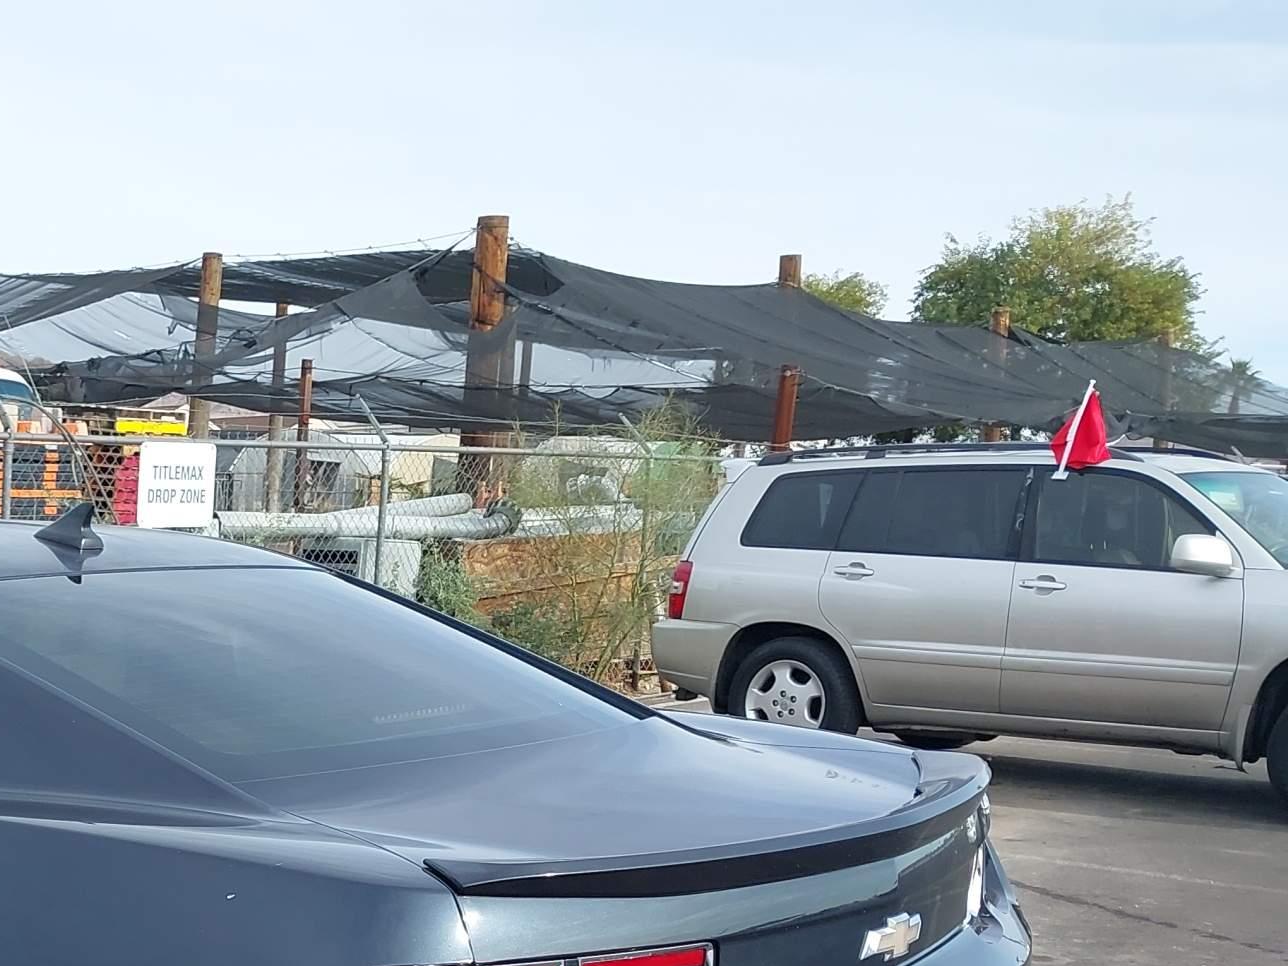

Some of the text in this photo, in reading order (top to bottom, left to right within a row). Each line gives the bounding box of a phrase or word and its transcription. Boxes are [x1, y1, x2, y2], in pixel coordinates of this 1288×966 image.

[153, 465, 204, 480] TITLEMAX
[147, 488, 206, 503] DROP ZONE
